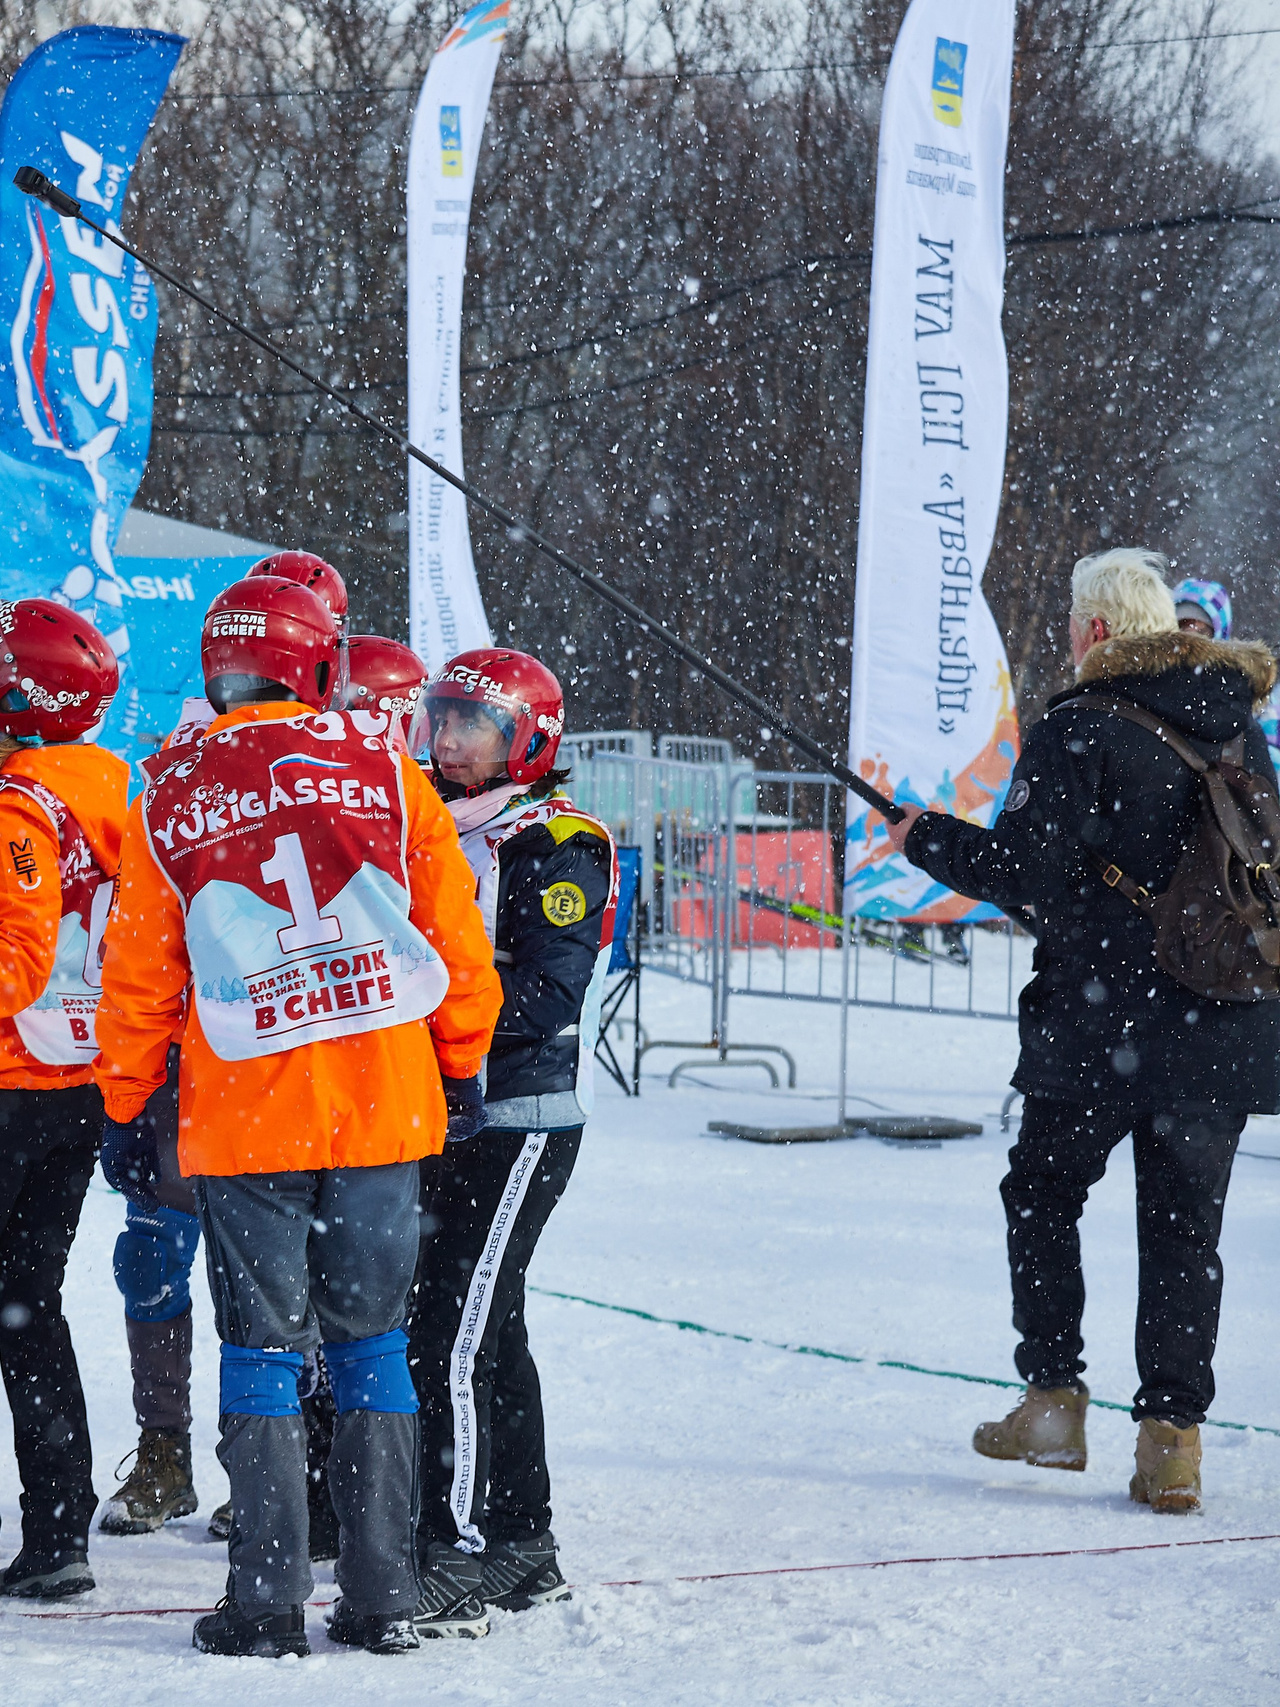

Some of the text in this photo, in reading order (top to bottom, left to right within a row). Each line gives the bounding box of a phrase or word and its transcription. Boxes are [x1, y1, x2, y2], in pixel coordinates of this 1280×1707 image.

[212, 624, 266, 638] В СНЕГЕ
[233, 614, 267, 625] ТОЛК
[153, 777, 391, 851] YUKIGASSEN
[195, 831, 235, 850] MURMANSK
[235, 822, 264, 836] REGION
[260, 832, 343, 954] 1
[248, 968, 305, 996] ДЛЯ ТЕХ,
[310, 949, 388, 983] ТОЛК
[251, 980, 307, 1004] КТО ЗНАЕТ
[255, 974, 394, 1031] В СНЕГЕ
[70, 1018, 90, 1041] В
[485, 1156, 531, 1265] SPORTIVE DIVISION
[465, 1282, 486, 1336] SPORTIVE
[460, 1404, 470, 1463] SPORTIVE
